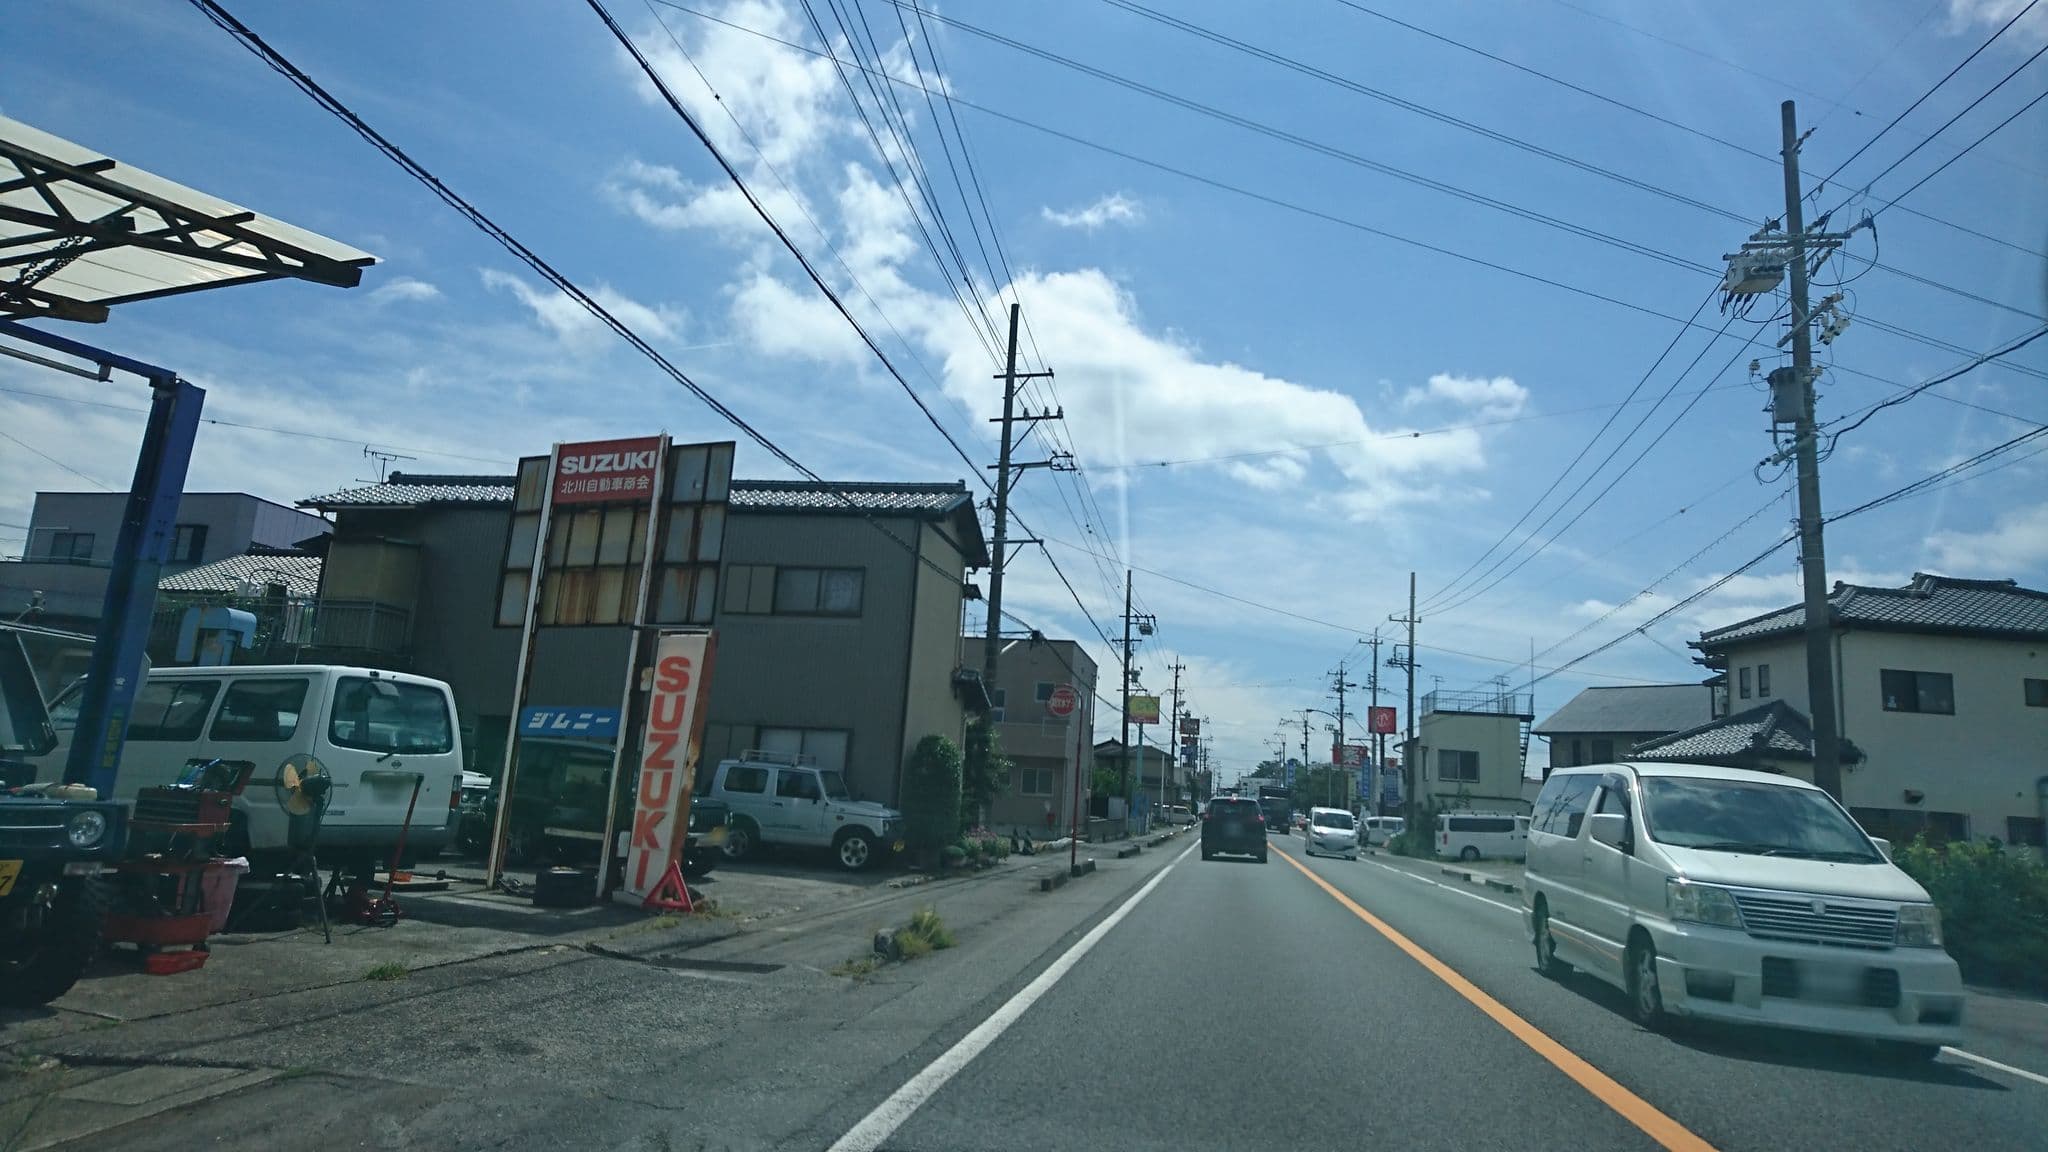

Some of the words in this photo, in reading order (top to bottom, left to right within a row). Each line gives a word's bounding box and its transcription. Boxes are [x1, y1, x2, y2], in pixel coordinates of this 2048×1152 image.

[561, 450, 657, 475] SUZUKI
[561, 475, 650, 494] 北川自動車商会
[528, 712, 612, 730] ジムニー
[632, 656, 691, 889] SUZUKI
